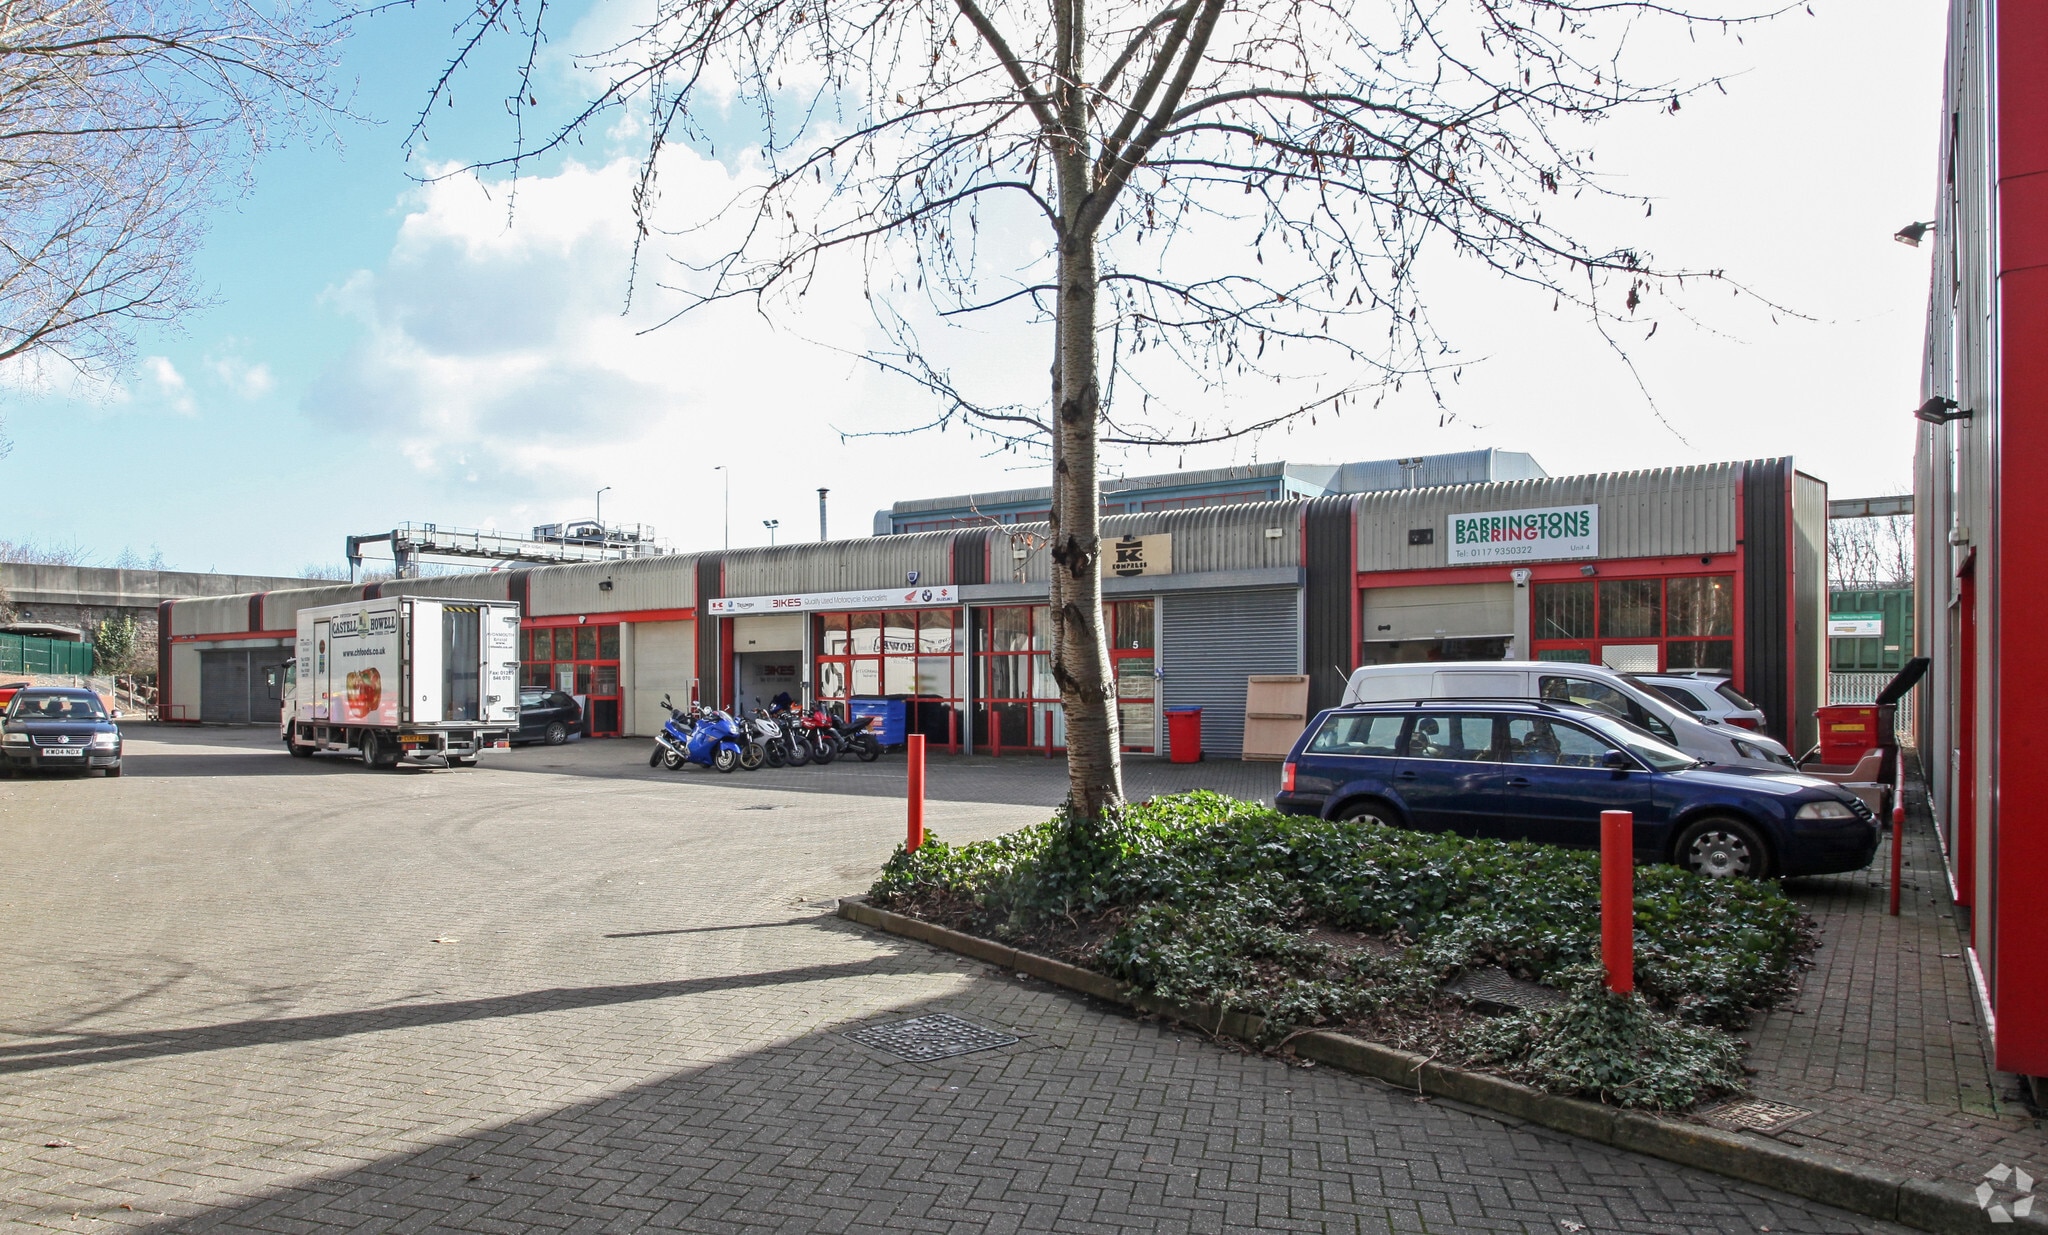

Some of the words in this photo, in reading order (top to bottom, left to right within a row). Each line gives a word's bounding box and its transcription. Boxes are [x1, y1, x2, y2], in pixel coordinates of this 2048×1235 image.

[1455, 510, 1590, 532] BARRINGTONS
[1455, 522, 1590, 544] BARRINGTONS
[1456, 549, 1469, 557] Tel:
[1471, 548, 1492, 557] 0117
[1495, 546, 1533, 555] 9350322
[1112, 562, 1147, 570] KOMPRESS
[833, 596, 860, 604] Motorcycle
[862, 594, 888, 602] Specialists
[332, 620, 358, 634] CASTELL
[370, 616, 396, 630] HOWELL
[1132, 641, 1139, 649] 5
[343, 647, 386, 657] www.chfoods.co.uk
